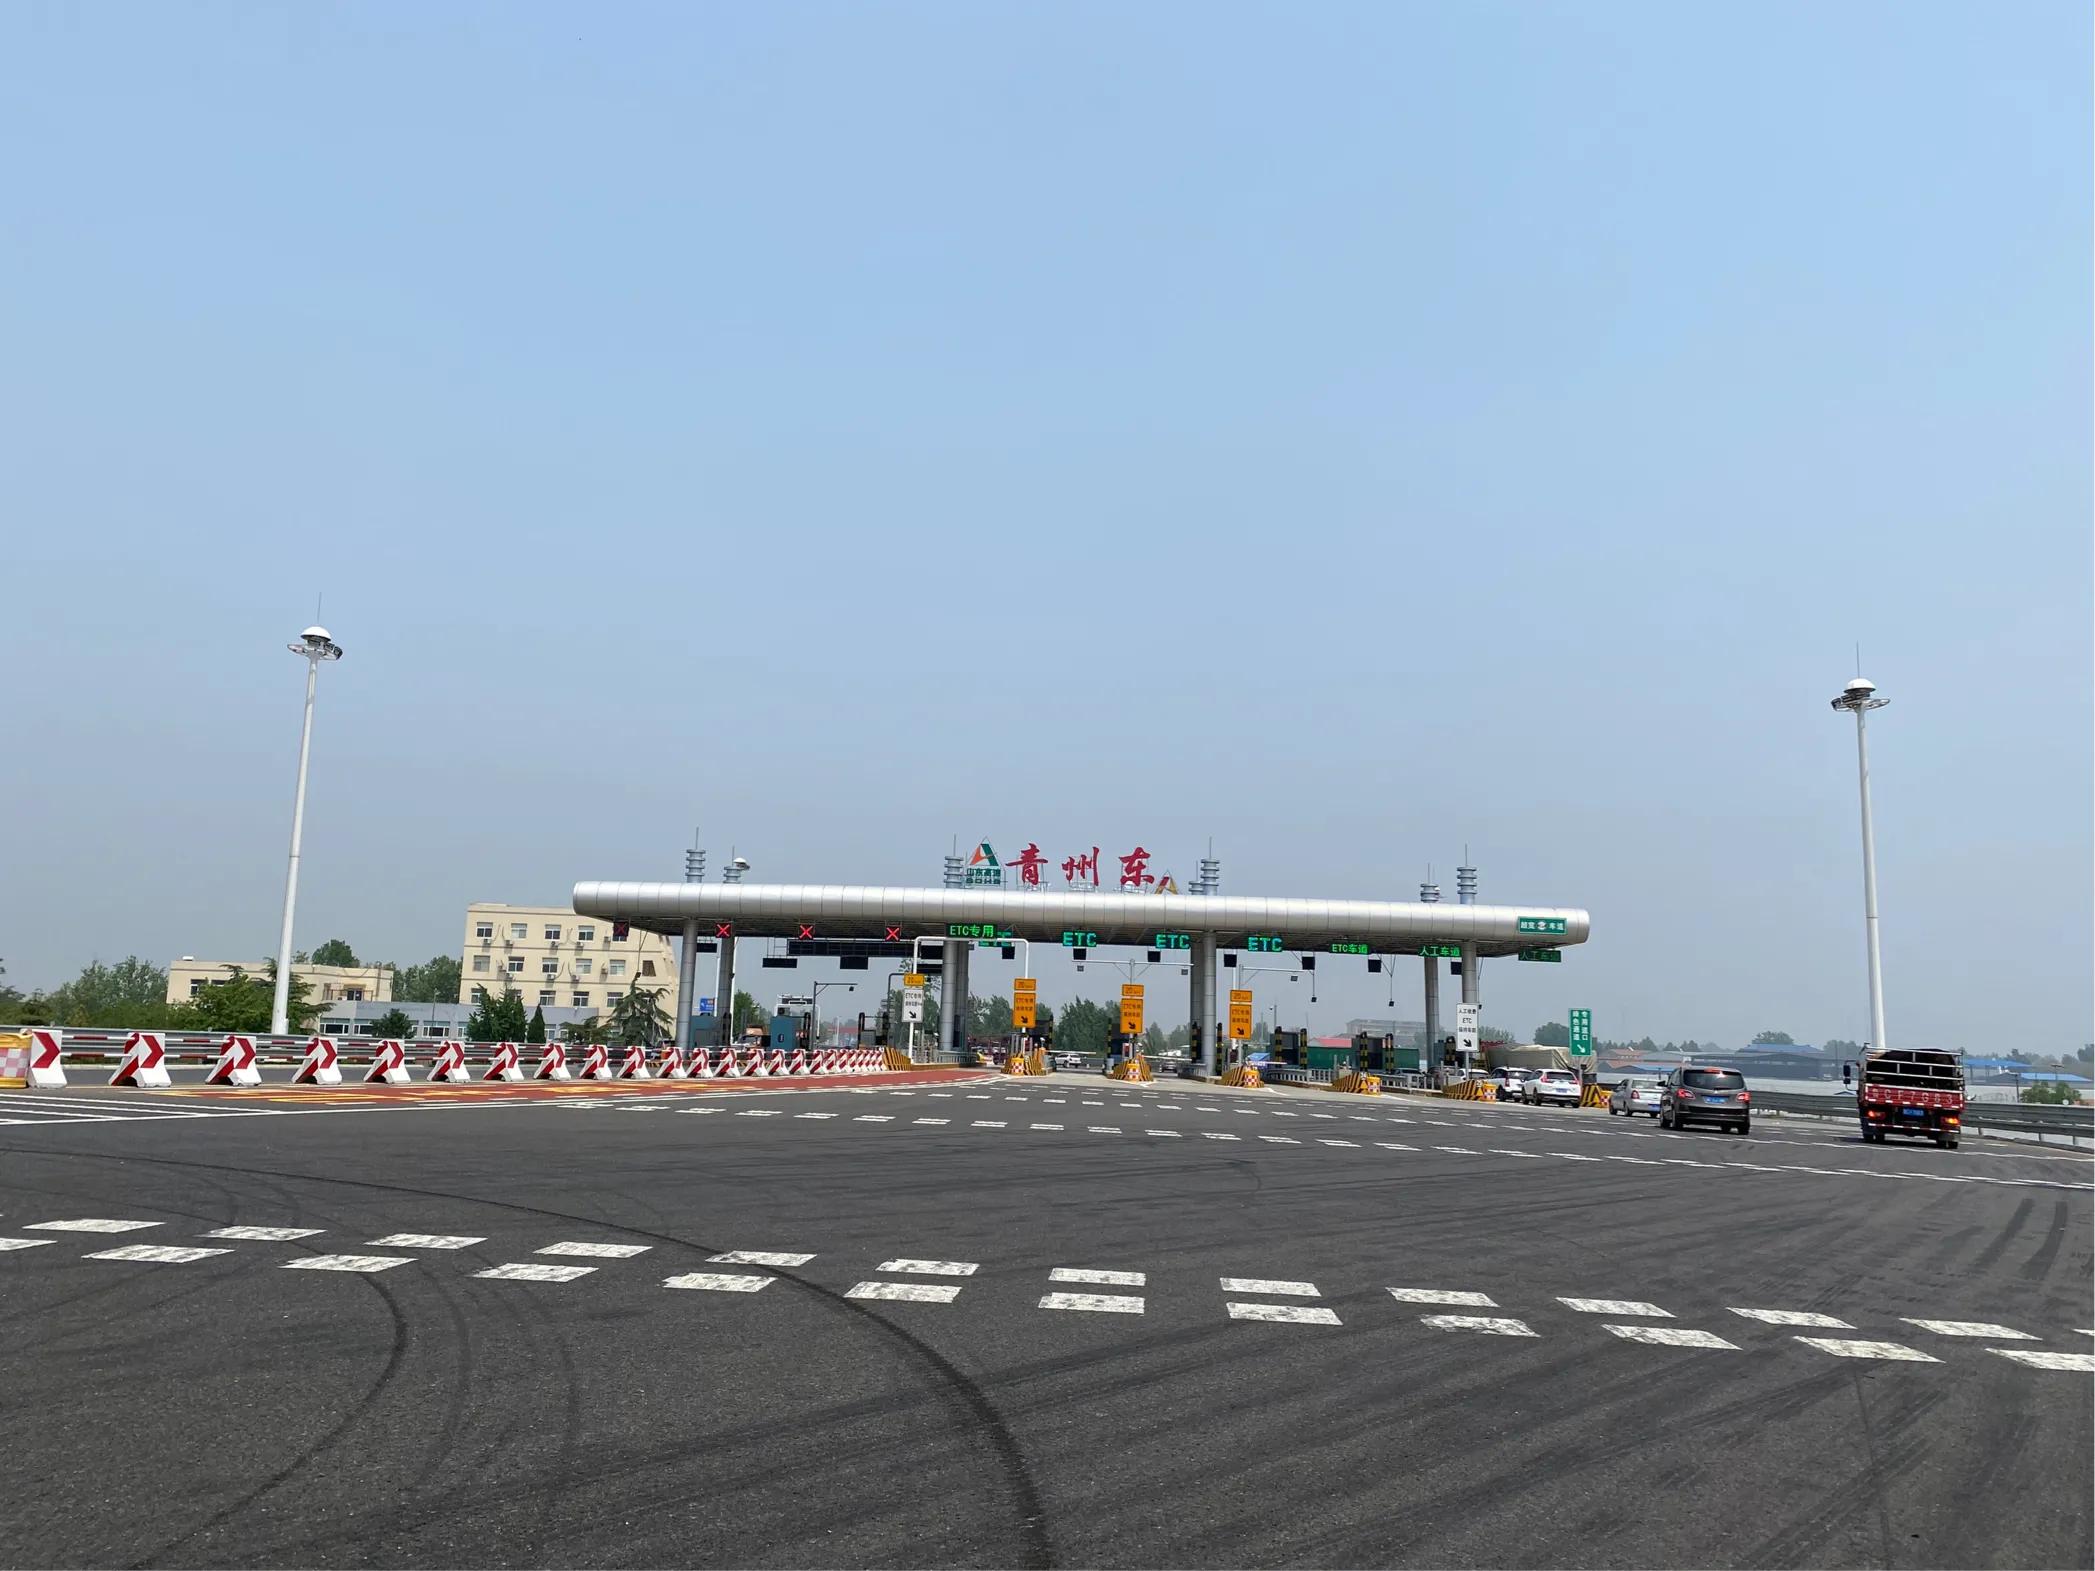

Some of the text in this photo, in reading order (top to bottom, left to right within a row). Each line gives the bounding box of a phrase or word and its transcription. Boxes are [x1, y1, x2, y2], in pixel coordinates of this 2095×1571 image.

[1006, 843, 1155, 887] 青州东
[949, 925, 994, 937] ETC专用
[1063, 932, 1097, 946] ETC
[1156, 934, 1190, 948] ETC
[1248, 937, 1283, 951] ETC
[1332, 943, 1368, 954] ETC车道
[1419, 946, 1461, 956] 人工车道
